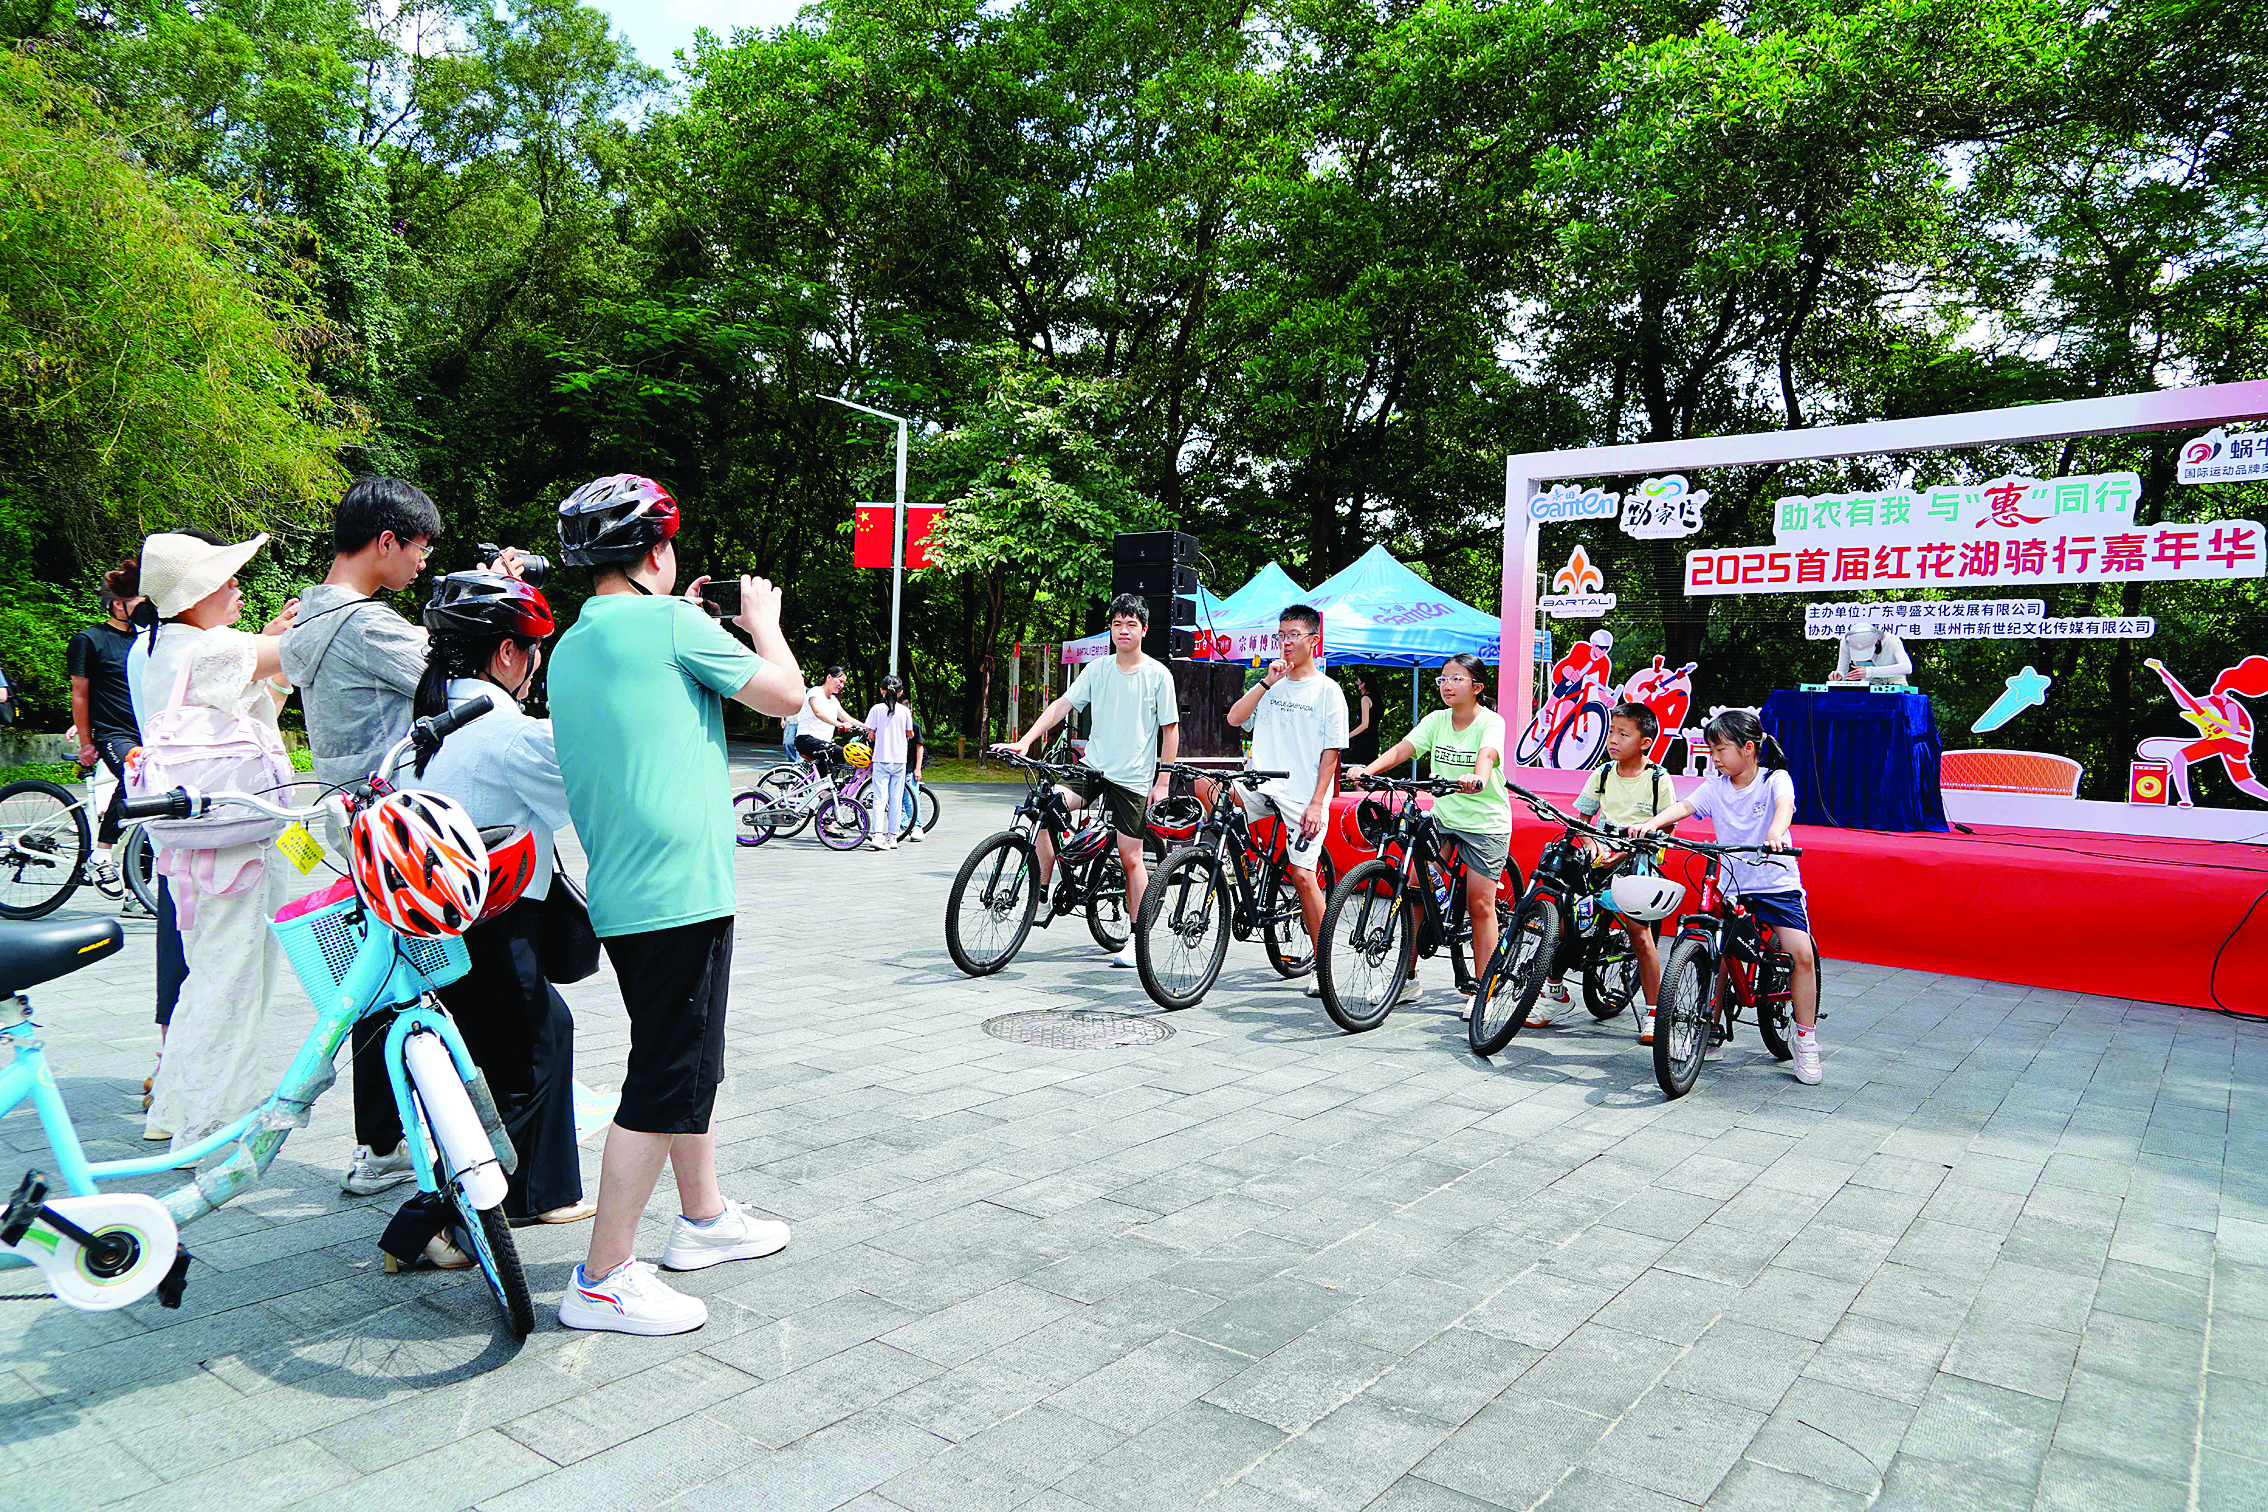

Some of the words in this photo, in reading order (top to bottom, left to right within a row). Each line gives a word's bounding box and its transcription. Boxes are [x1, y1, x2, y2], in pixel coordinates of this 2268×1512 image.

[1780, 495, 1911, 532] 助农有我
[1691, 527, 2257, 587] 2025首届红花湖骑行嘉年华
[1543, 598, 1612, 607] BARTALI
[1808, 602, 2041, 619] 主办单位：广东粤盛文化发展有限公司
[1933, 619, 2151, 636] 惠州市新世纪文化传媒有限公司
